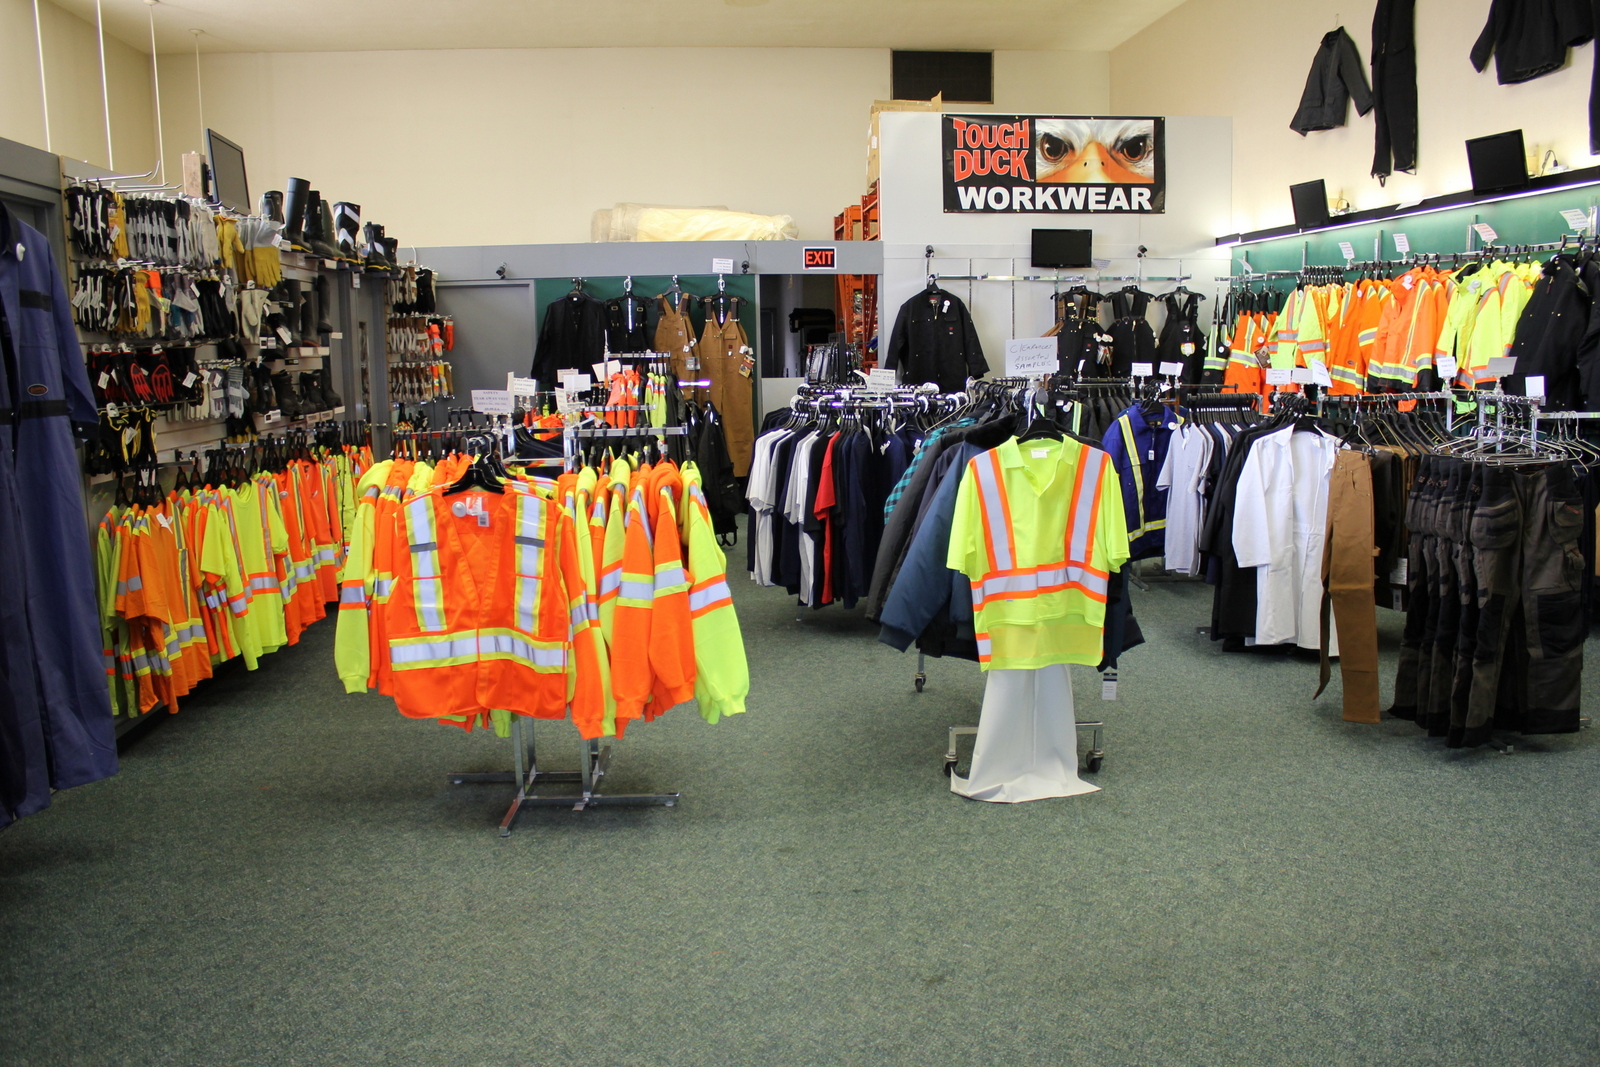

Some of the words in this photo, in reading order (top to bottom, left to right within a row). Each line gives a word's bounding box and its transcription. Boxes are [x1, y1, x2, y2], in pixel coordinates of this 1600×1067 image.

[953, 117, 1030, 149] TOUGH
[953, 149, 1030, 183] DUCK
[957, 186, 1153, 210] WORKWEAR
[805, 250, 834, 265] EXIT
